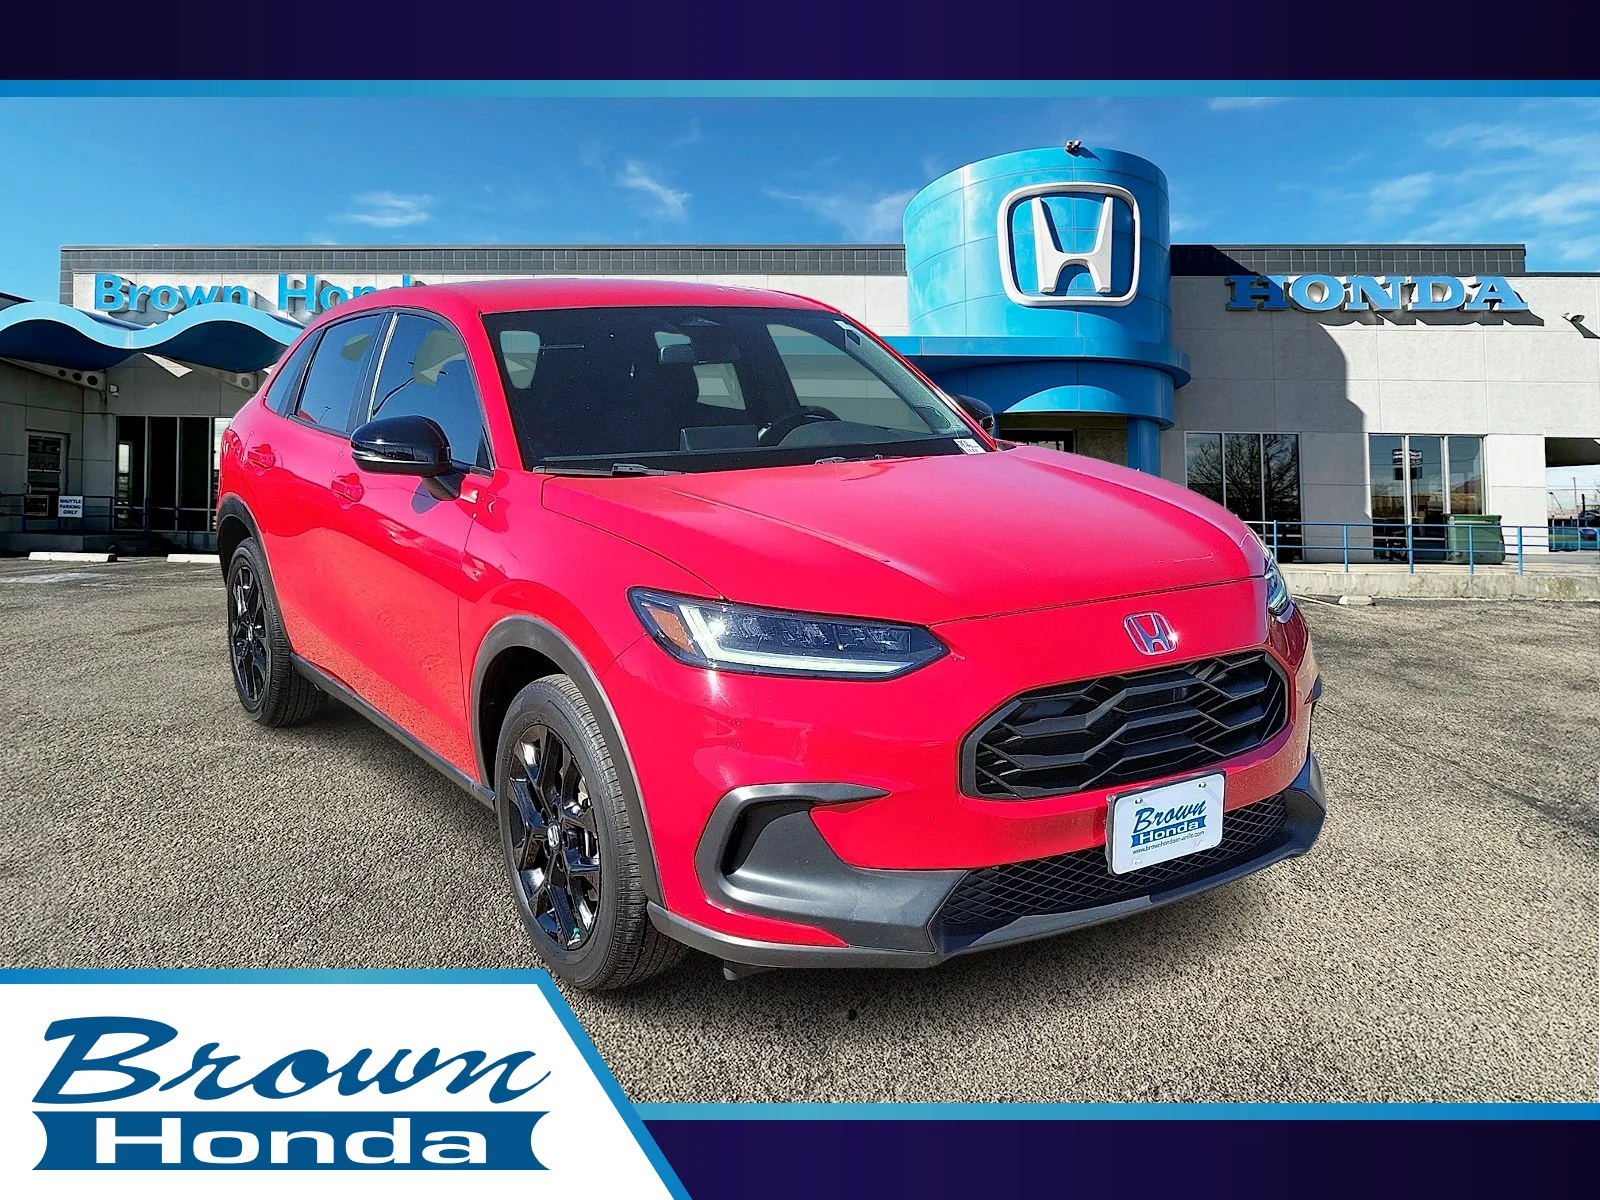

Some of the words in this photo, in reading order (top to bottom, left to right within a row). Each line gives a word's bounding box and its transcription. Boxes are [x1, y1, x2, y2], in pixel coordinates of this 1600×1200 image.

[94, 274, 249, 311] Brown
[1226, 274, 1529, 311] HONDA
[1133, 800, 1206, 832] Brown
[1140, 821, 1199, 844] Honda
